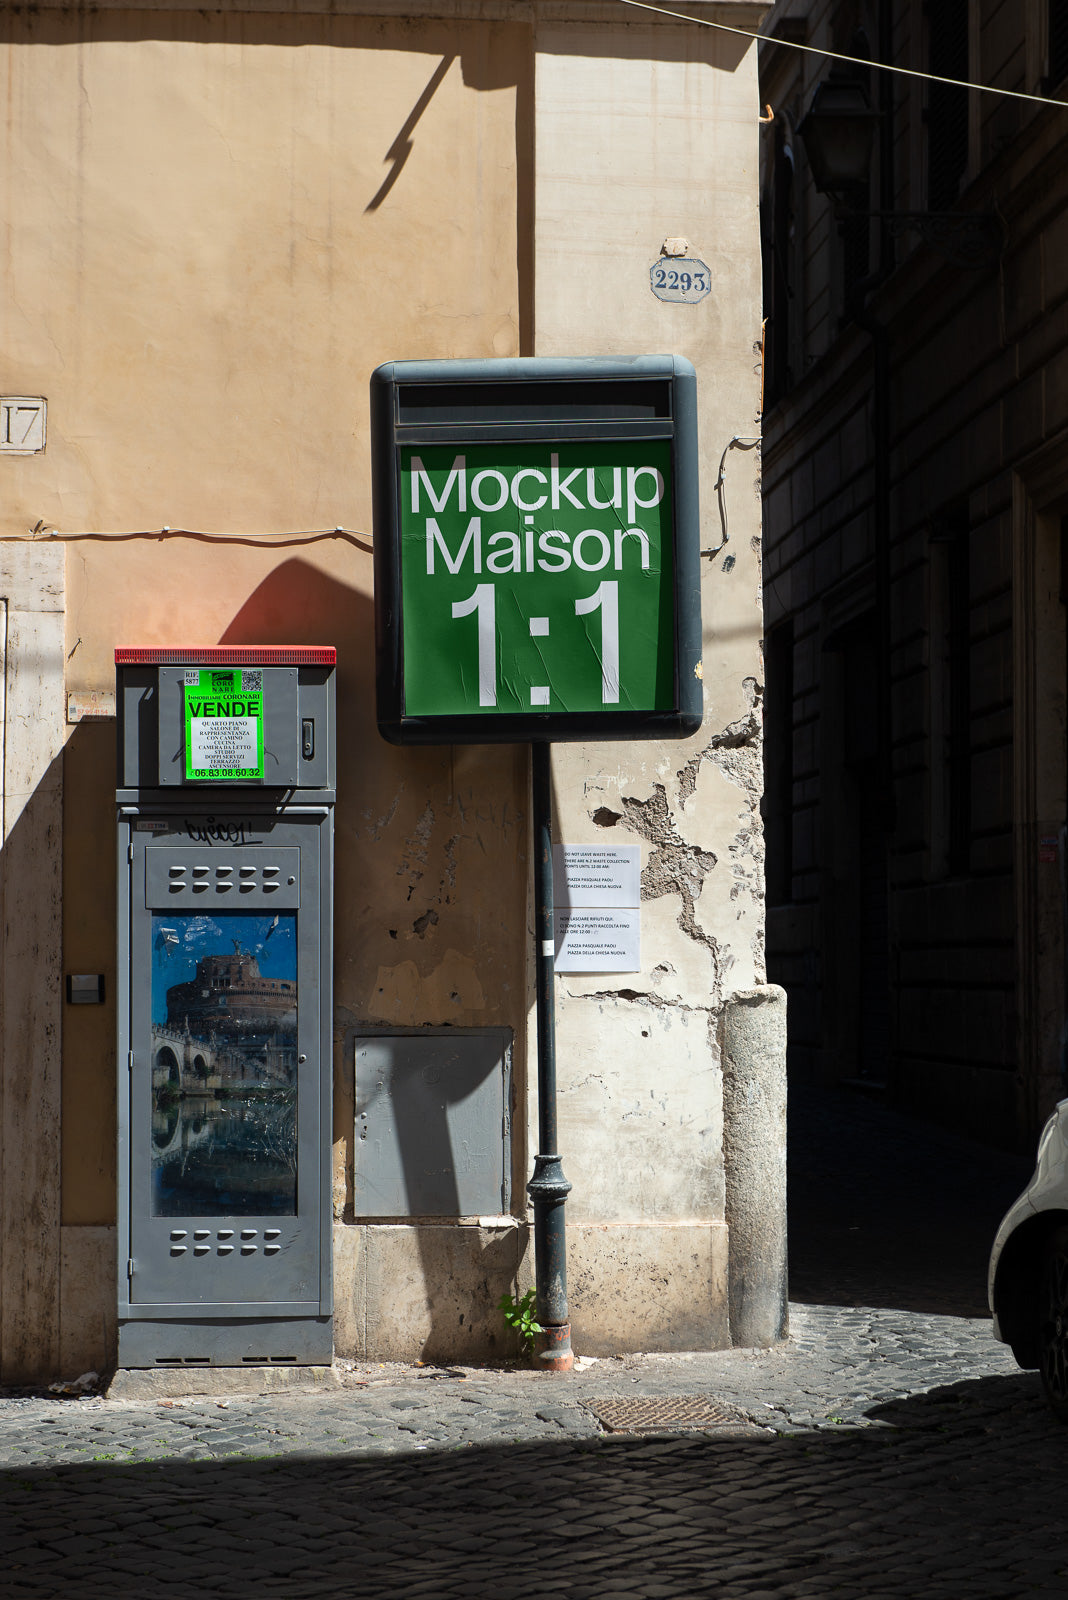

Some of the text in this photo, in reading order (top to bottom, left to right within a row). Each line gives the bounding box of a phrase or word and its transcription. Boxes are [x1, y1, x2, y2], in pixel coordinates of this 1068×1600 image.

[2, 406, 40, 444] 17
[410, 453, 664, 524] Mockup
[426, 516, 650, 574] Maison
[452, 580, 620, 706] 1:1
[189, 702, 259, 717] VENDE
[195, 769, 260, 777] 06.83.08.60.32
